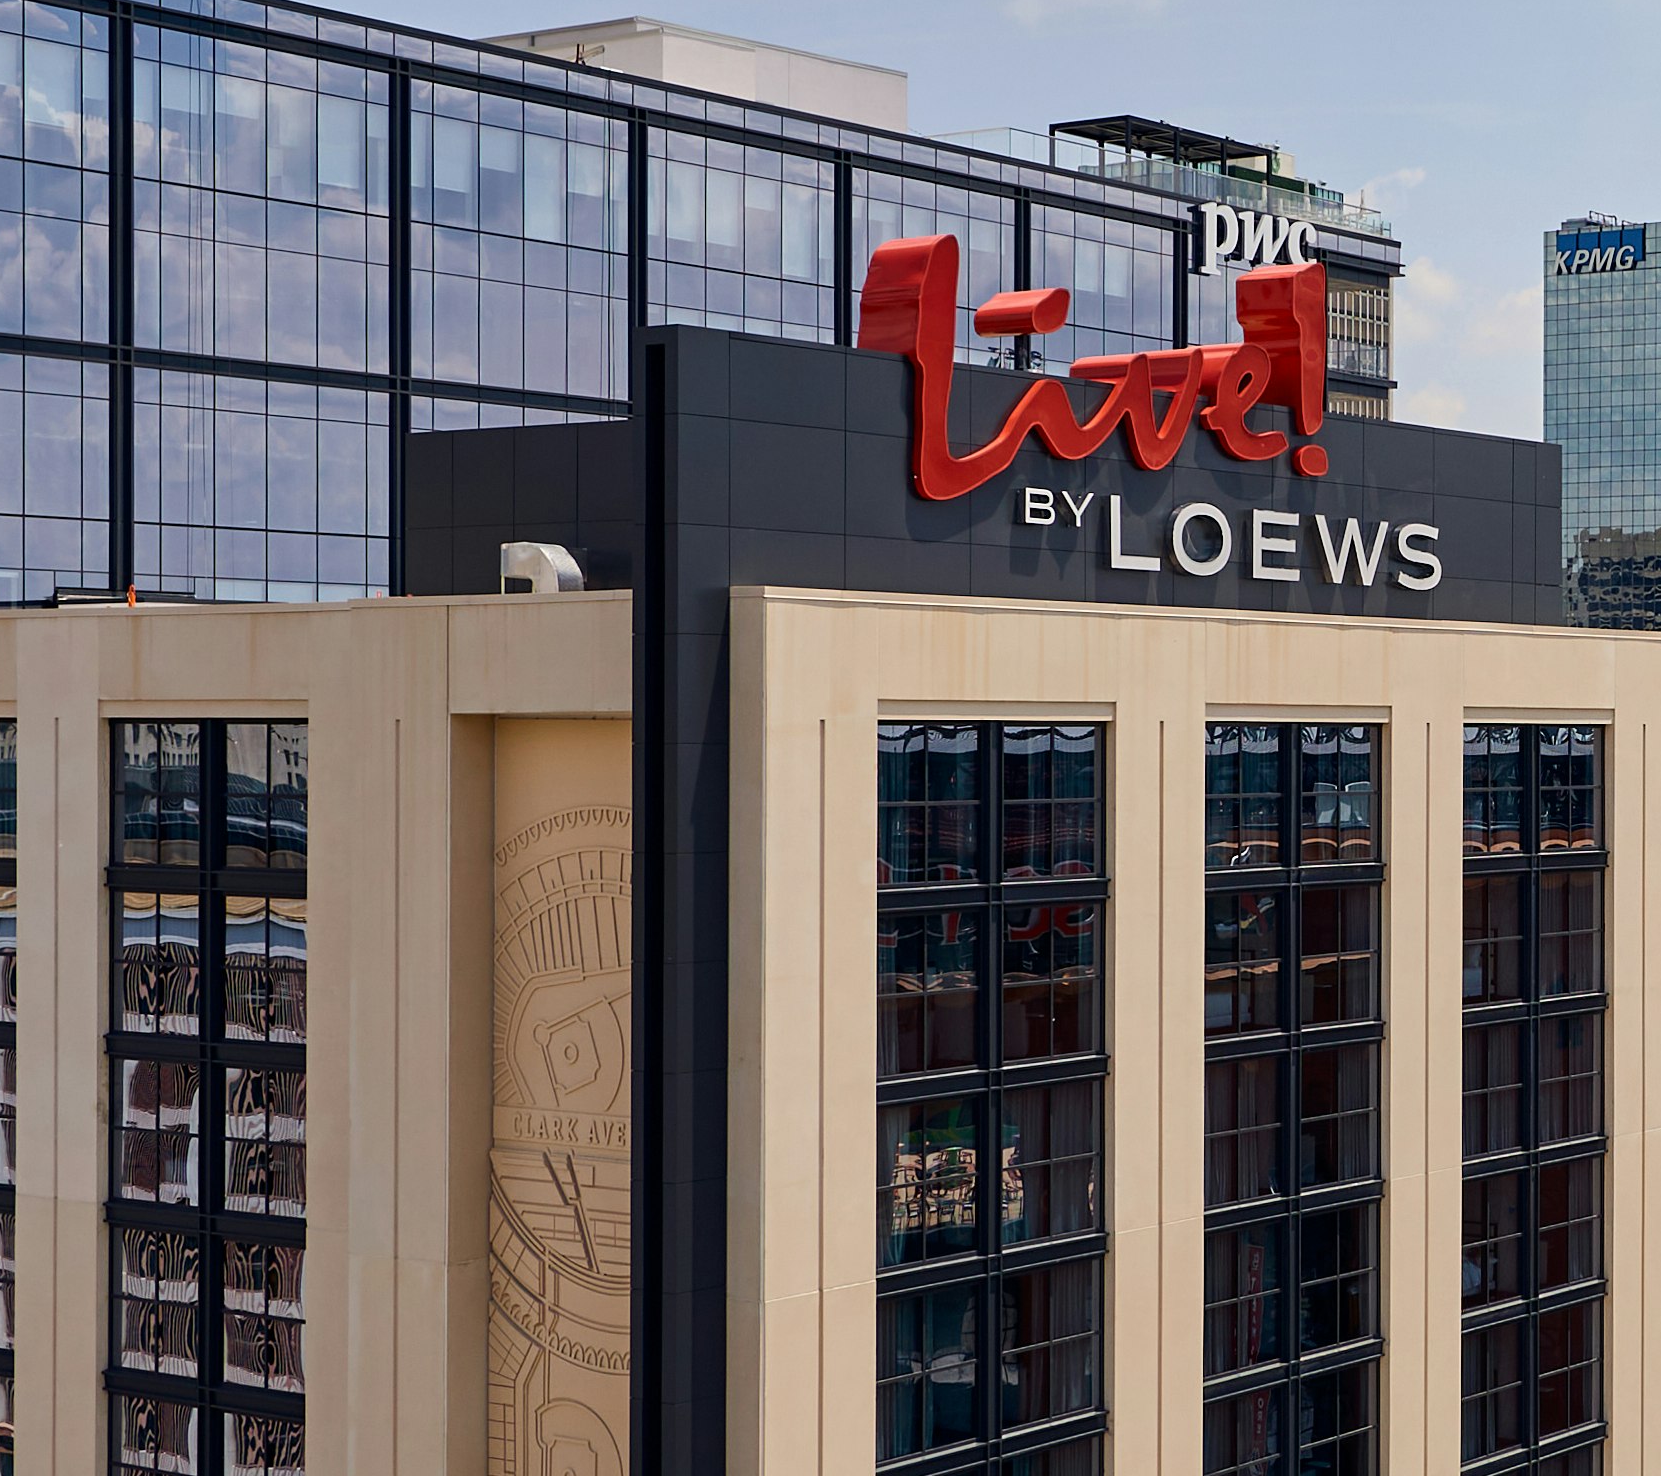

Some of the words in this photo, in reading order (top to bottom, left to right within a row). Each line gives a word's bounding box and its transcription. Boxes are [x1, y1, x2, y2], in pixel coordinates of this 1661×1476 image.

[1200, 202, 1317, 275] pwc
[1553, 245, 1635, 274] KPMG
[857, 233, 1328, 501] Live!
[1024, 486, 1094, 527] BY
[1109, 494, 1443, 592] LOEWS
[513, 1111, 579, 1143] CLARK
[589, 1120, 626, 1147] AVE
